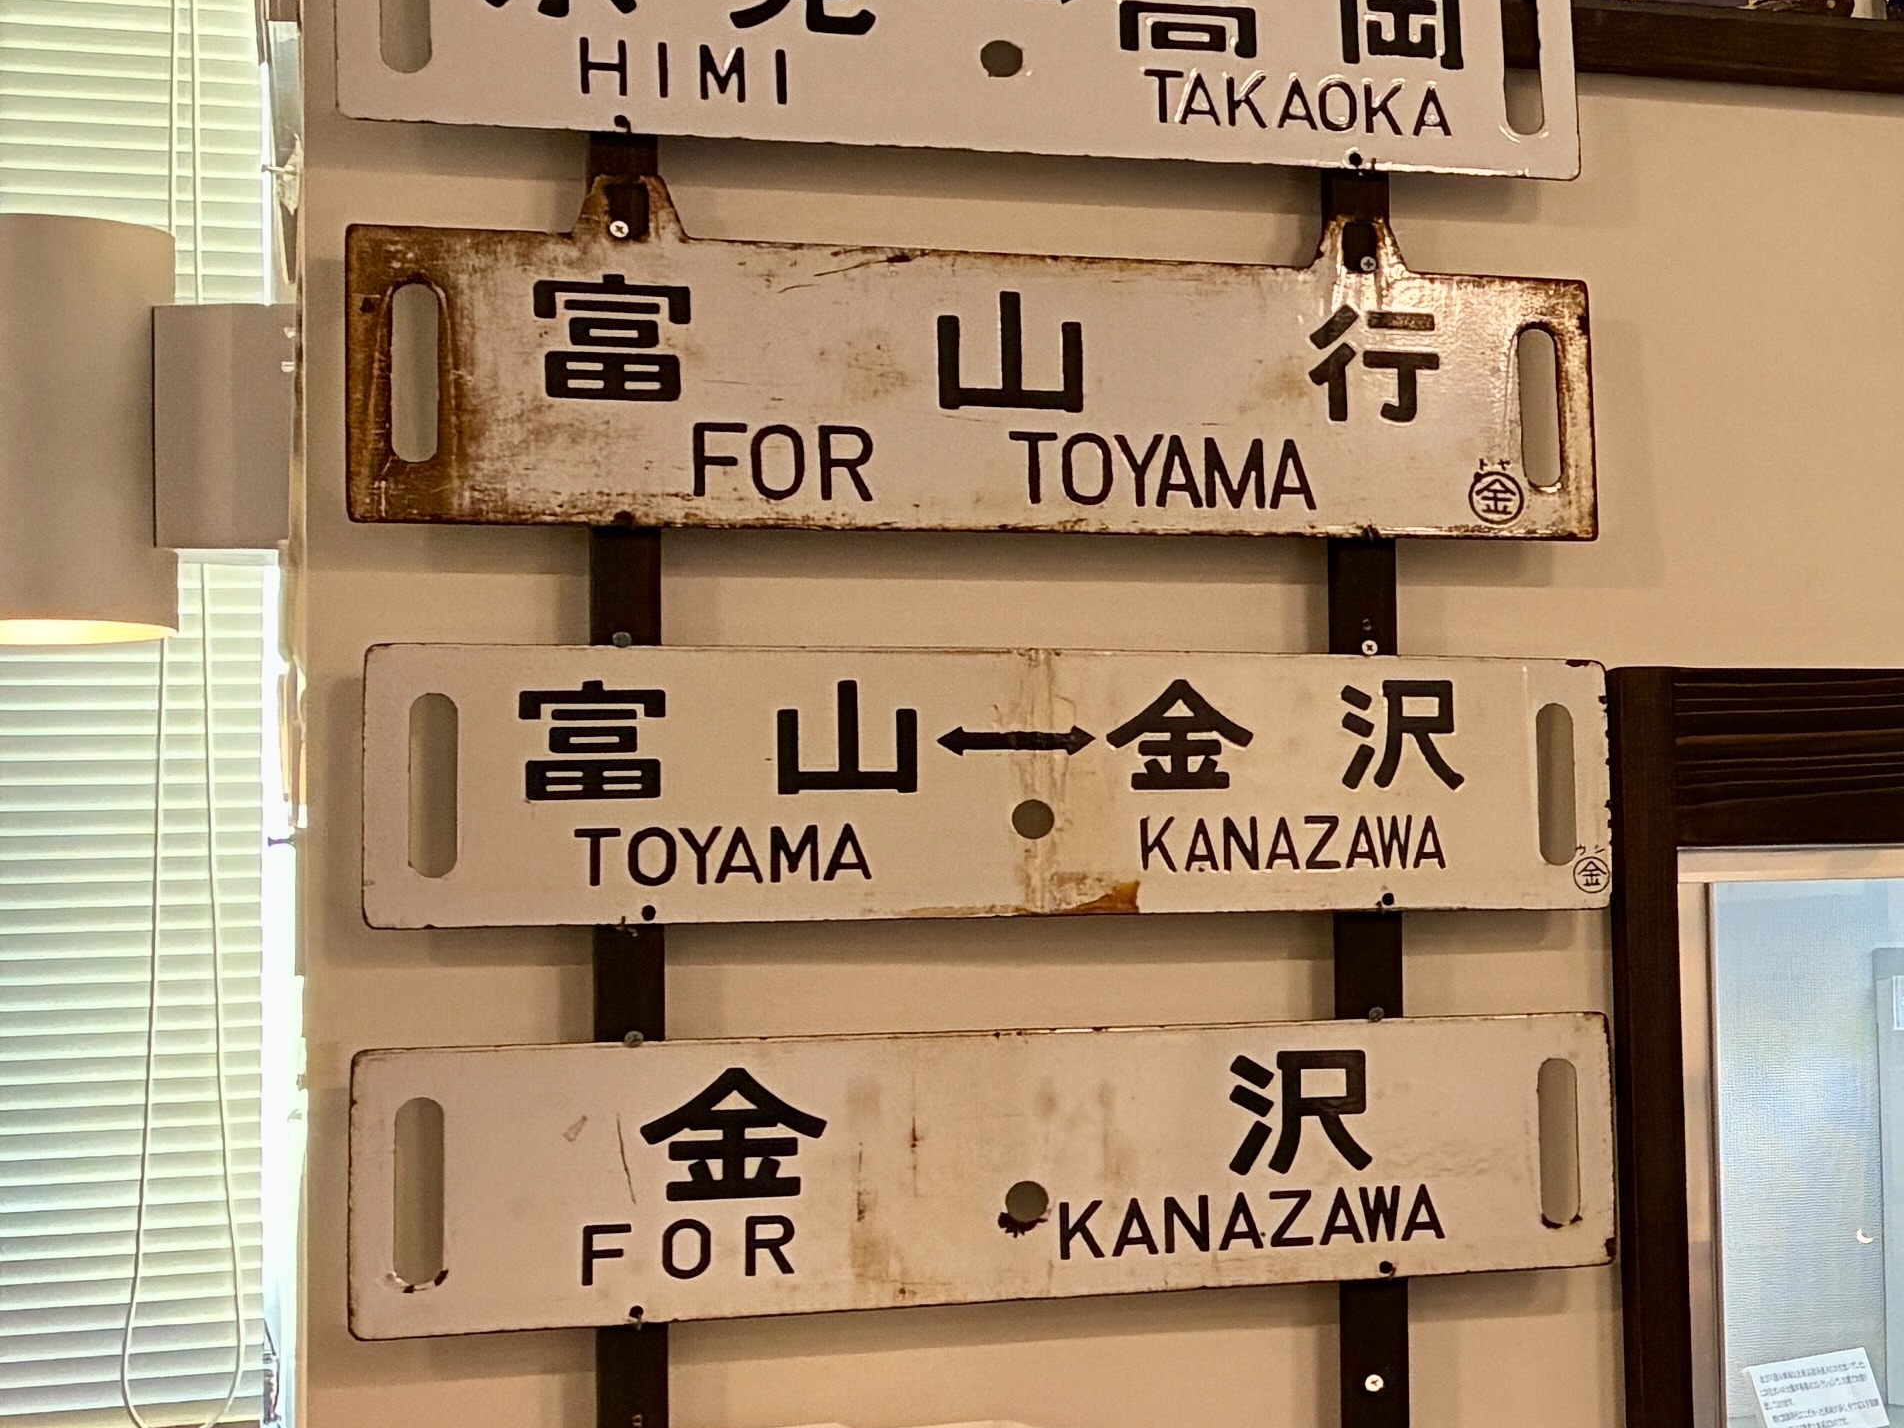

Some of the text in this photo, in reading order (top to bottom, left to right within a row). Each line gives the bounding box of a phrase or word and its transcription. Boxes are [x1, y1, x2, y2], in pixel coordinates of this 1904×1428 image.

[578, 35, 1453, 140] HIMI TAKAOKA
[532, 273, 1442, 425] 富山行
[691, 422, 1318, 513] FOR TOYAMA
[518, 677, 1467, 803] 富山 金沢
[574, 813, 1447, 889] TOYAMA KANAZAWA
[640, 1048, 1374, 1203] 金沢
[580, 1183, 1446, 1288] FOR KANAZAWA
